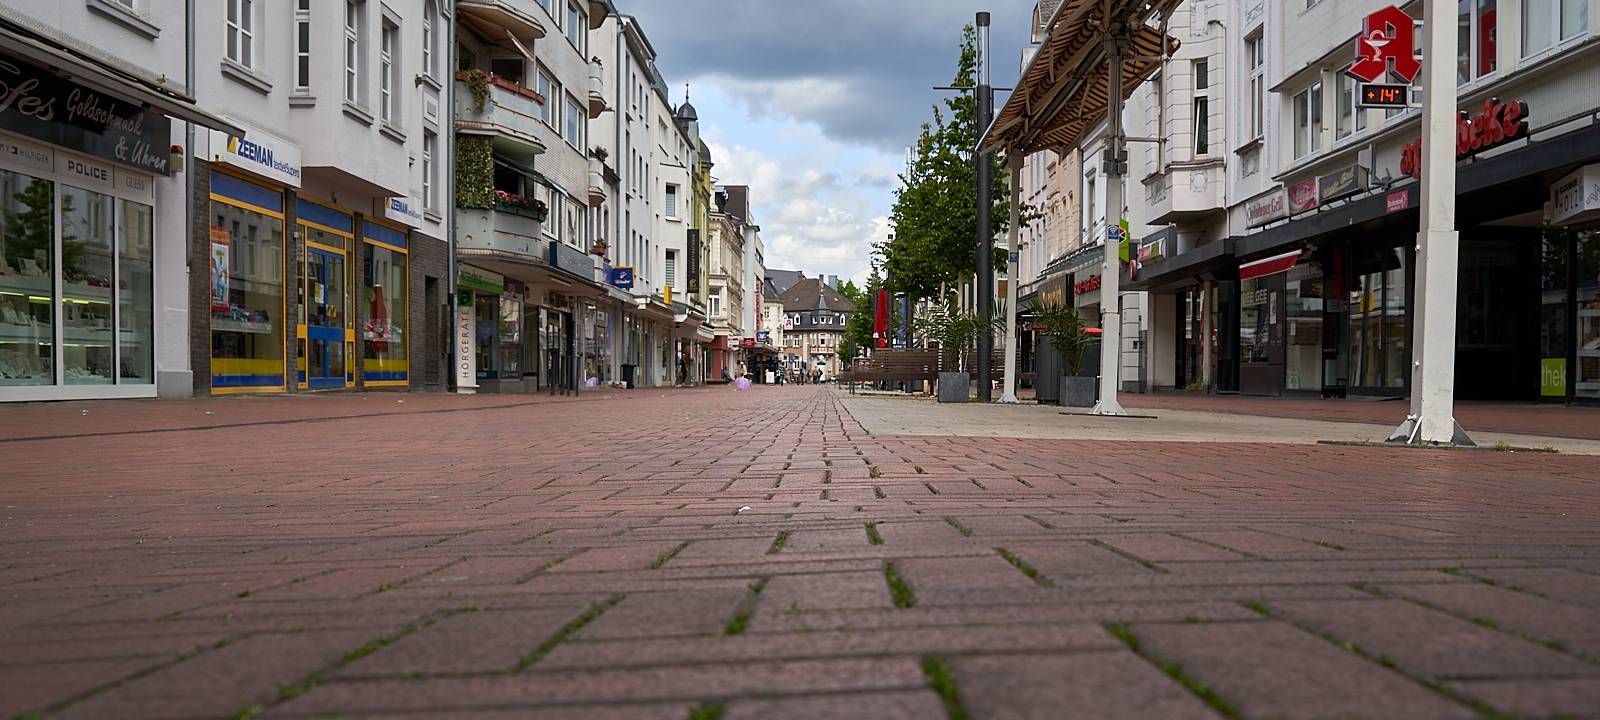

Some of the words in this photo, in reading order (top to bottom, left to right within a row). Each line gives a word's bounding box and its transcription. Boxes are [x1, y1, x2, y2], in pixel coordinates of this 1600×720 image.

[114, 135, 129, 161] &
[131, 140, 167, 173] Uhren
[238, 138, 273, 169] ZEEMAN
[67, 159, 107, 181] POLICE
